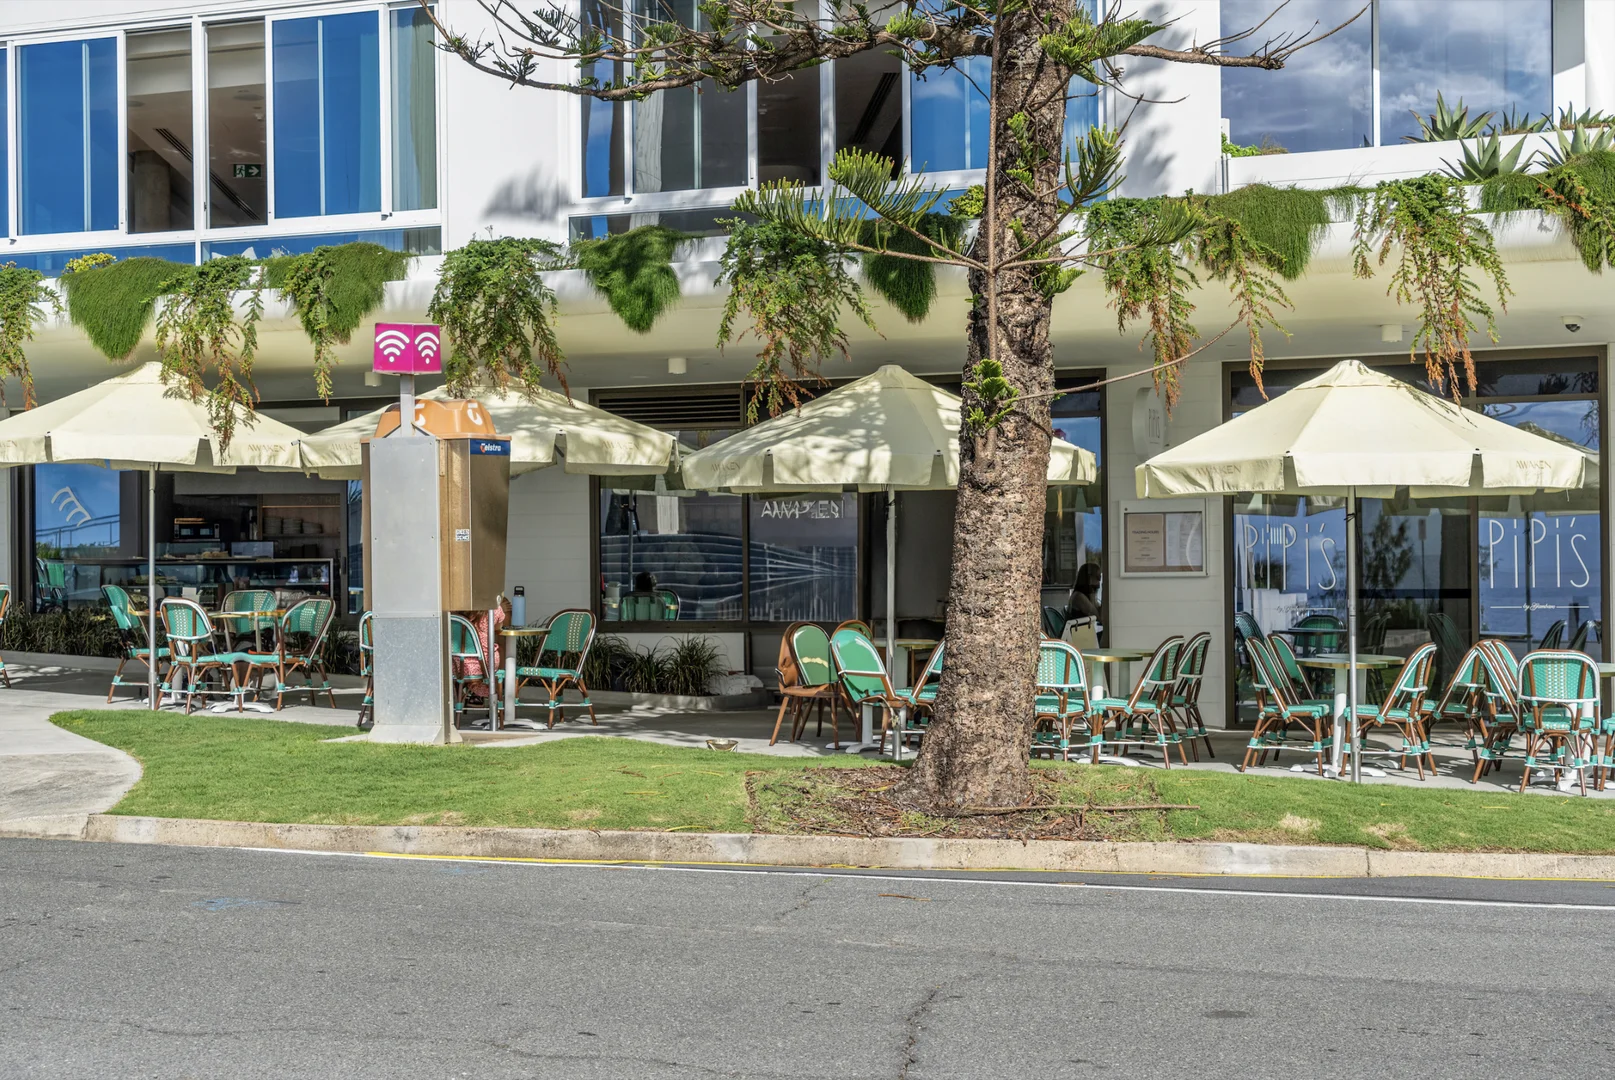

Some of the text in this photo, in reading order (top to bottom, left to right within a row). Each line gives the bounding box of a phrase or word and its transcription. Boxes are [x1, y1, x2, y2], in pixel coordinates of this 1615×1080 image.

[247, 444, 286, 453] AWAKEN
[480, 443, 501, 453] Telstra
[710, 461, 741, 471] AWAKEN
[1516, 460, 1552, 470] AWAKEN
[1195, 465, 1241, 476] AWAKEN
